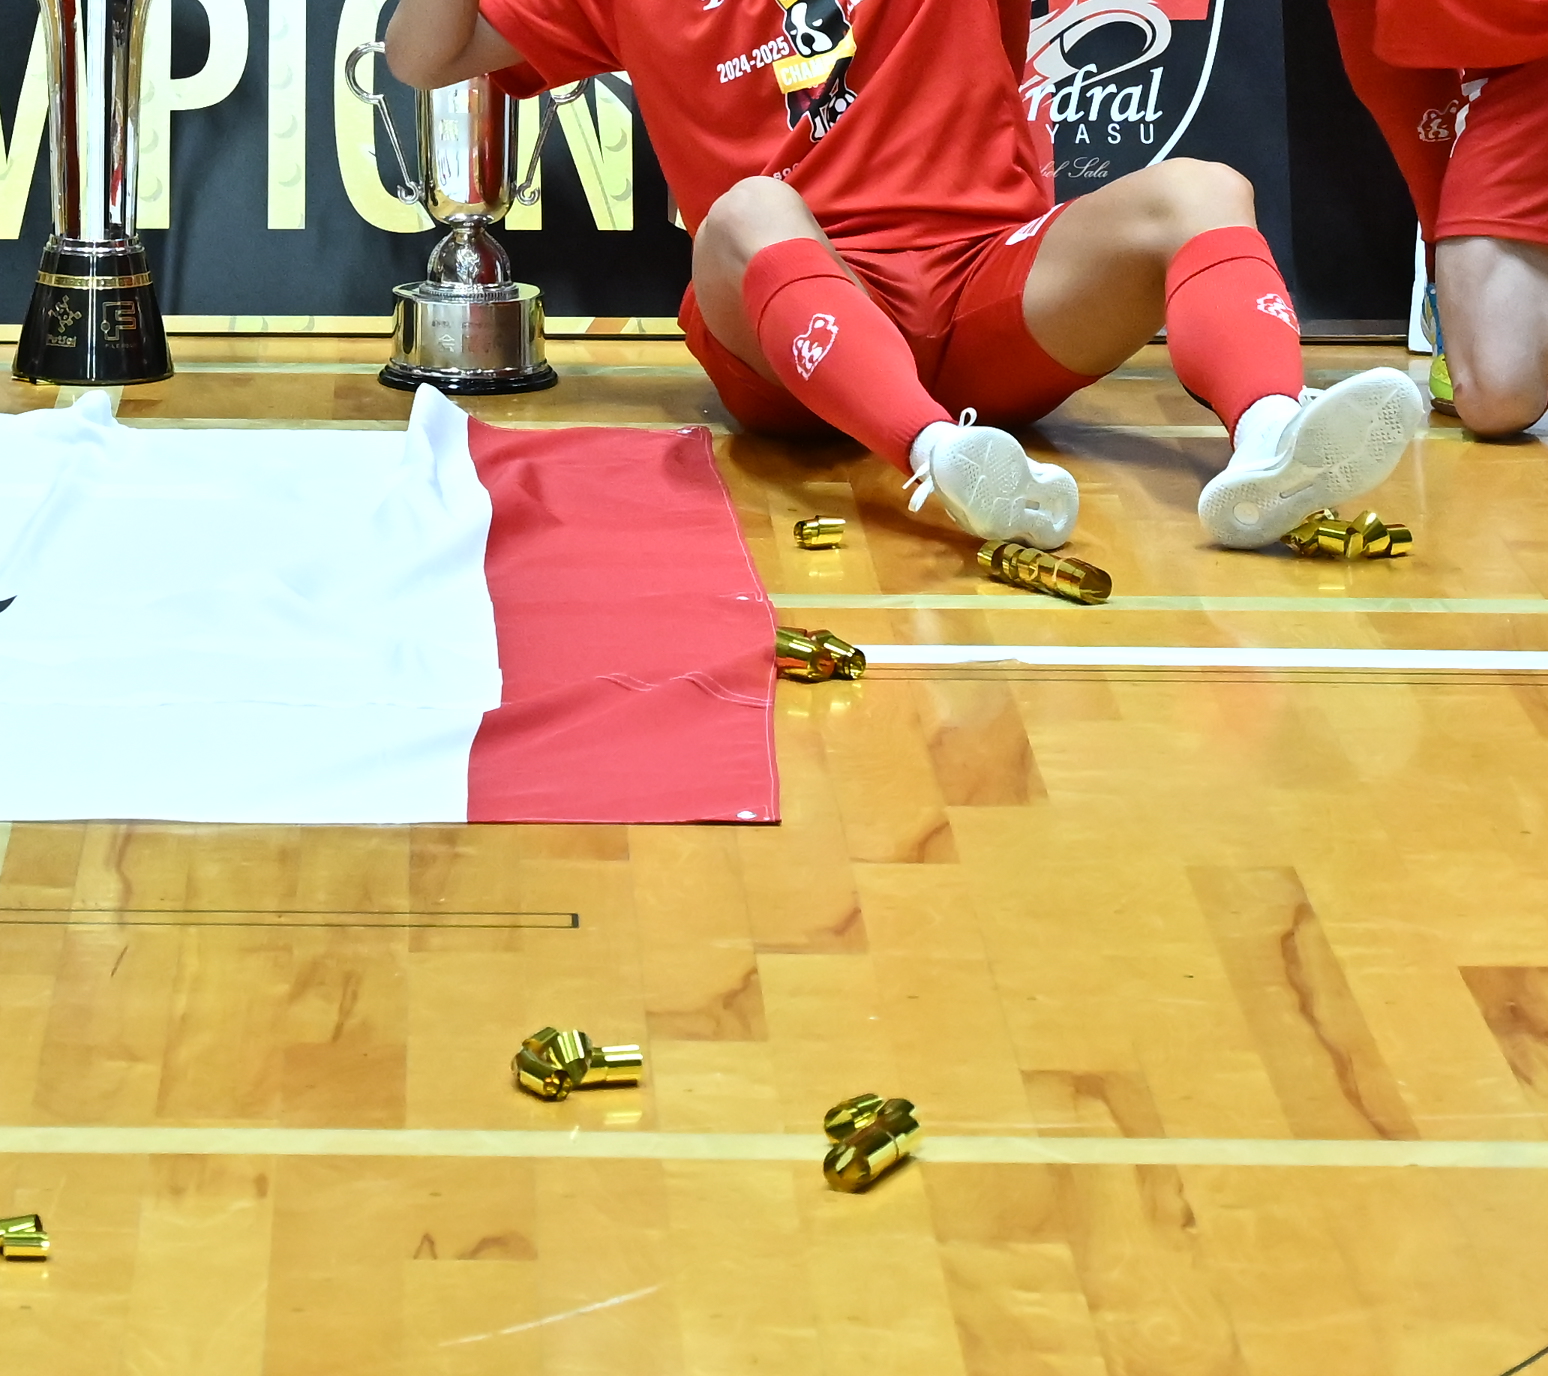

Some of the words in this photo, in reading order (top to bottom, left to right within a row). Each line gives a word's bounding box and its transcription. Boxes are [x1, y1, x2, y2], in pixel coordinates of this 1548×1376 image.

[716, 36, 790, 84] 2024-2025
[1025, 63, 1164, 122] rdral
[1068, 156, 1110, 178] Sala
